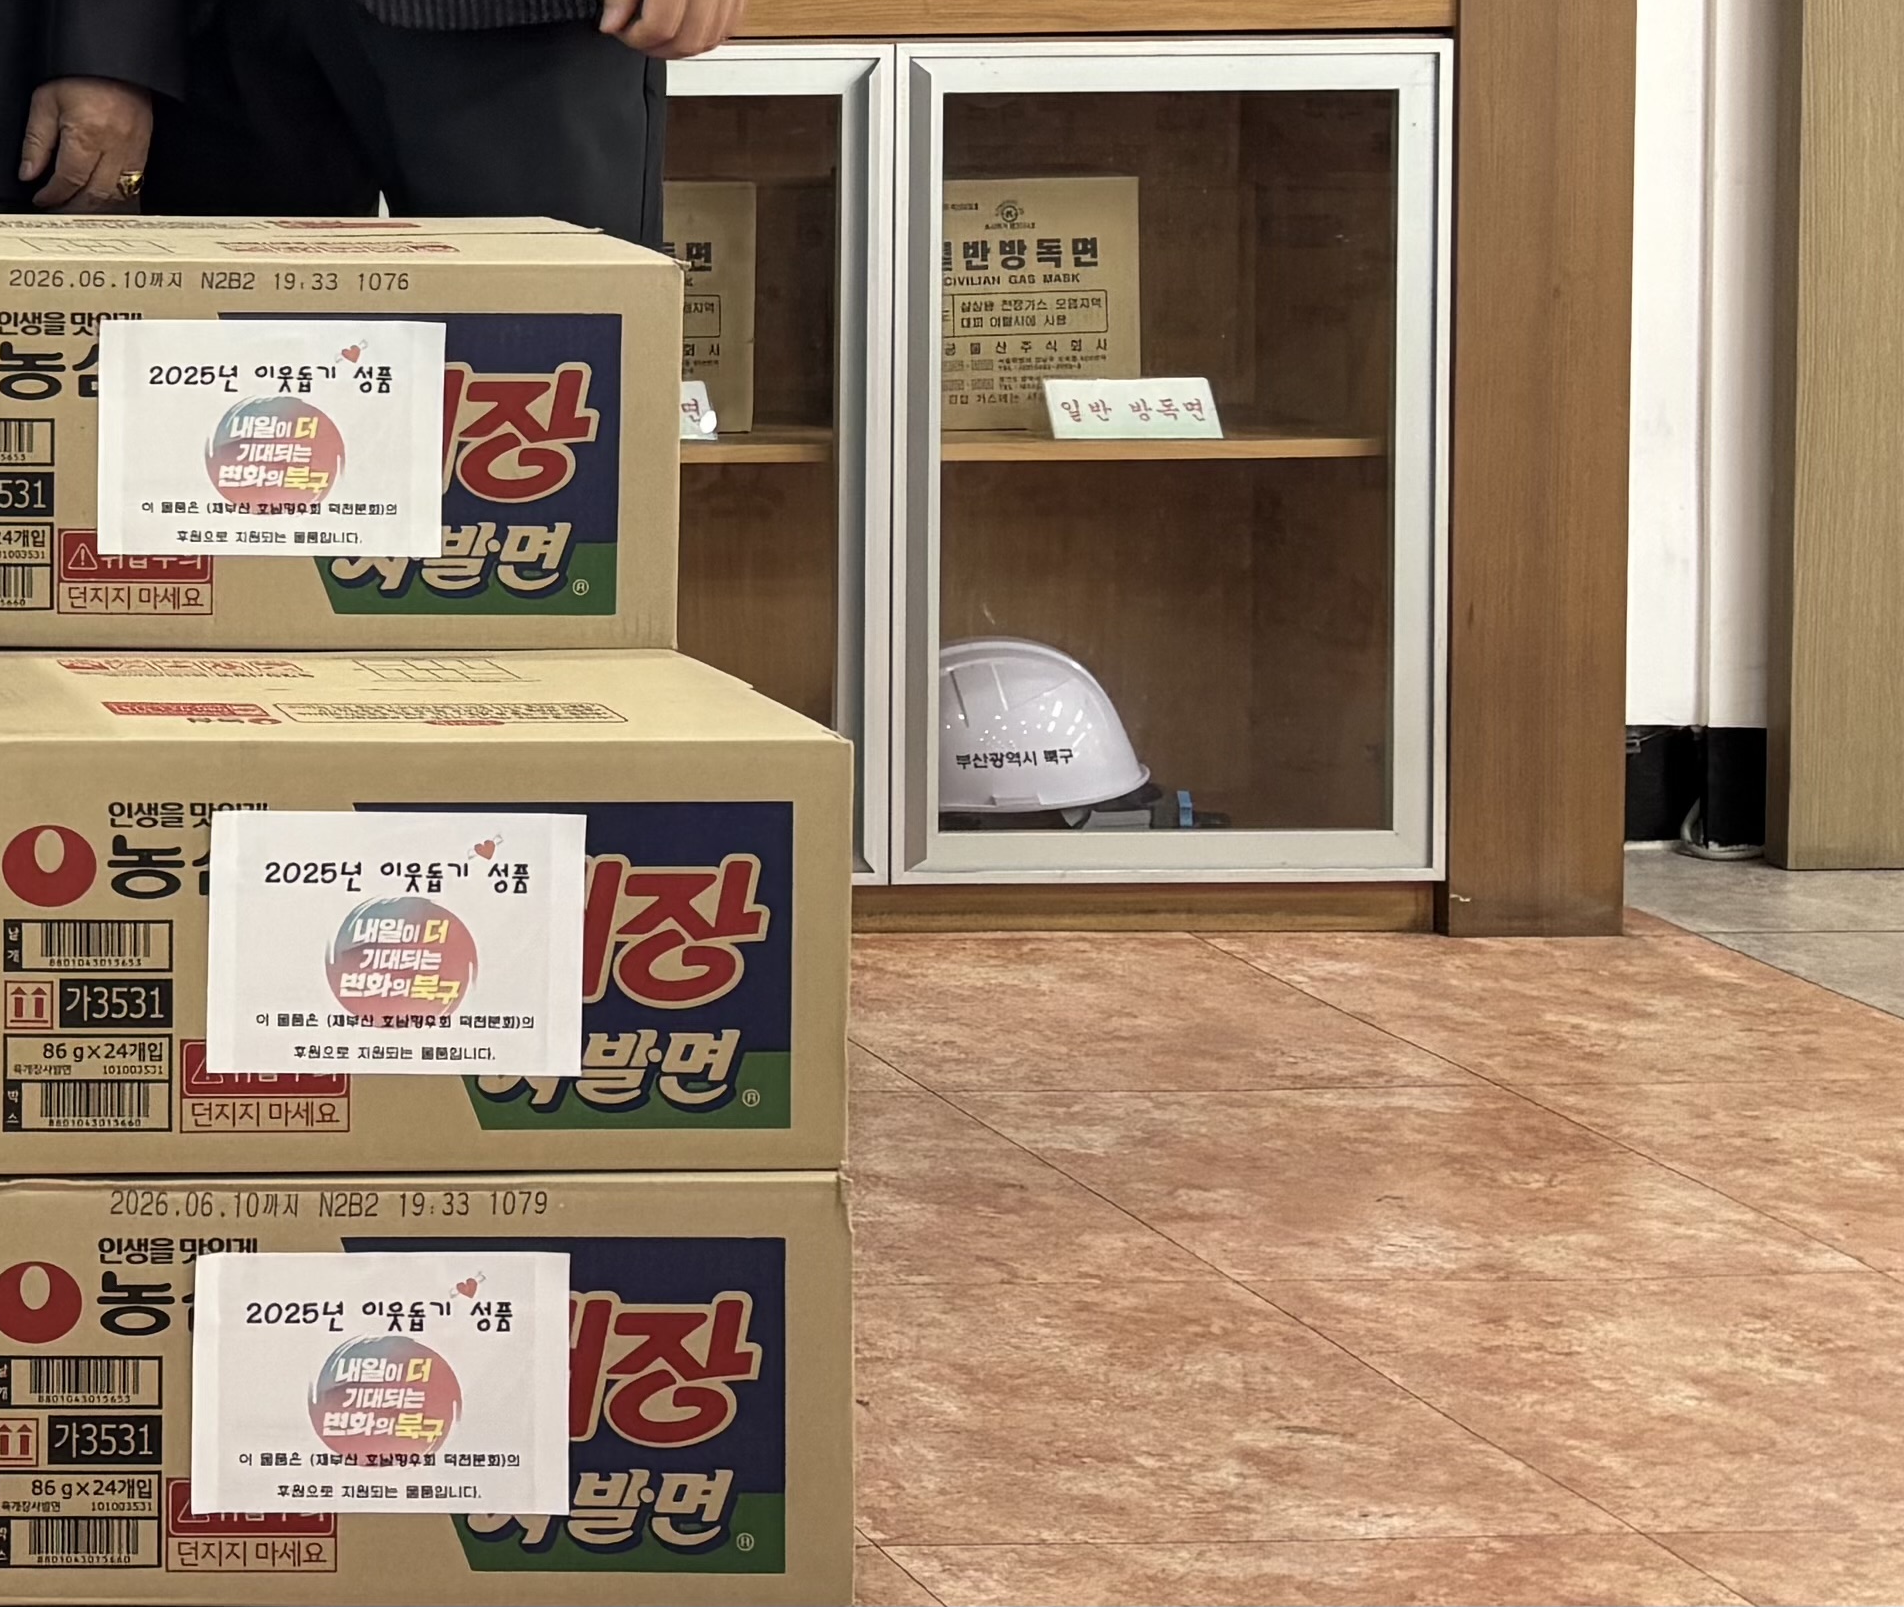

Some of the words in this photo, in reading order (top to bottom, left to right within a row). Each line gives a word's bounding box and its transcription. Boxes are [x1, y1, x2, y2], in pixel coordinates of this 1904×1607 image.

[201, 272, 255, 289] N2B2
[275, 273, 337, 290] 19:33
[359, 273, 408, 291] 1076
[1009, 274, 1035, 284] GAS
[1061, 399, 1112, 422] 일반
[1129, 398, 1205, 421] 방독면
[956, 751, 1037, 770] 부산광역시
[265, 862, 361, 891] 2025년
[381, 862, 468, 893] 이웃돕기
[488, 863, 529, 893] 성품
[66, 986, 164, 1021] 가3531
[318, 1189, 379, 1219] N2B2
[400, 1192, 469, 1217] 19:33
[485, 1185, 547, 1215] 1079
[55, 1423, 152, 1458] 가3531
